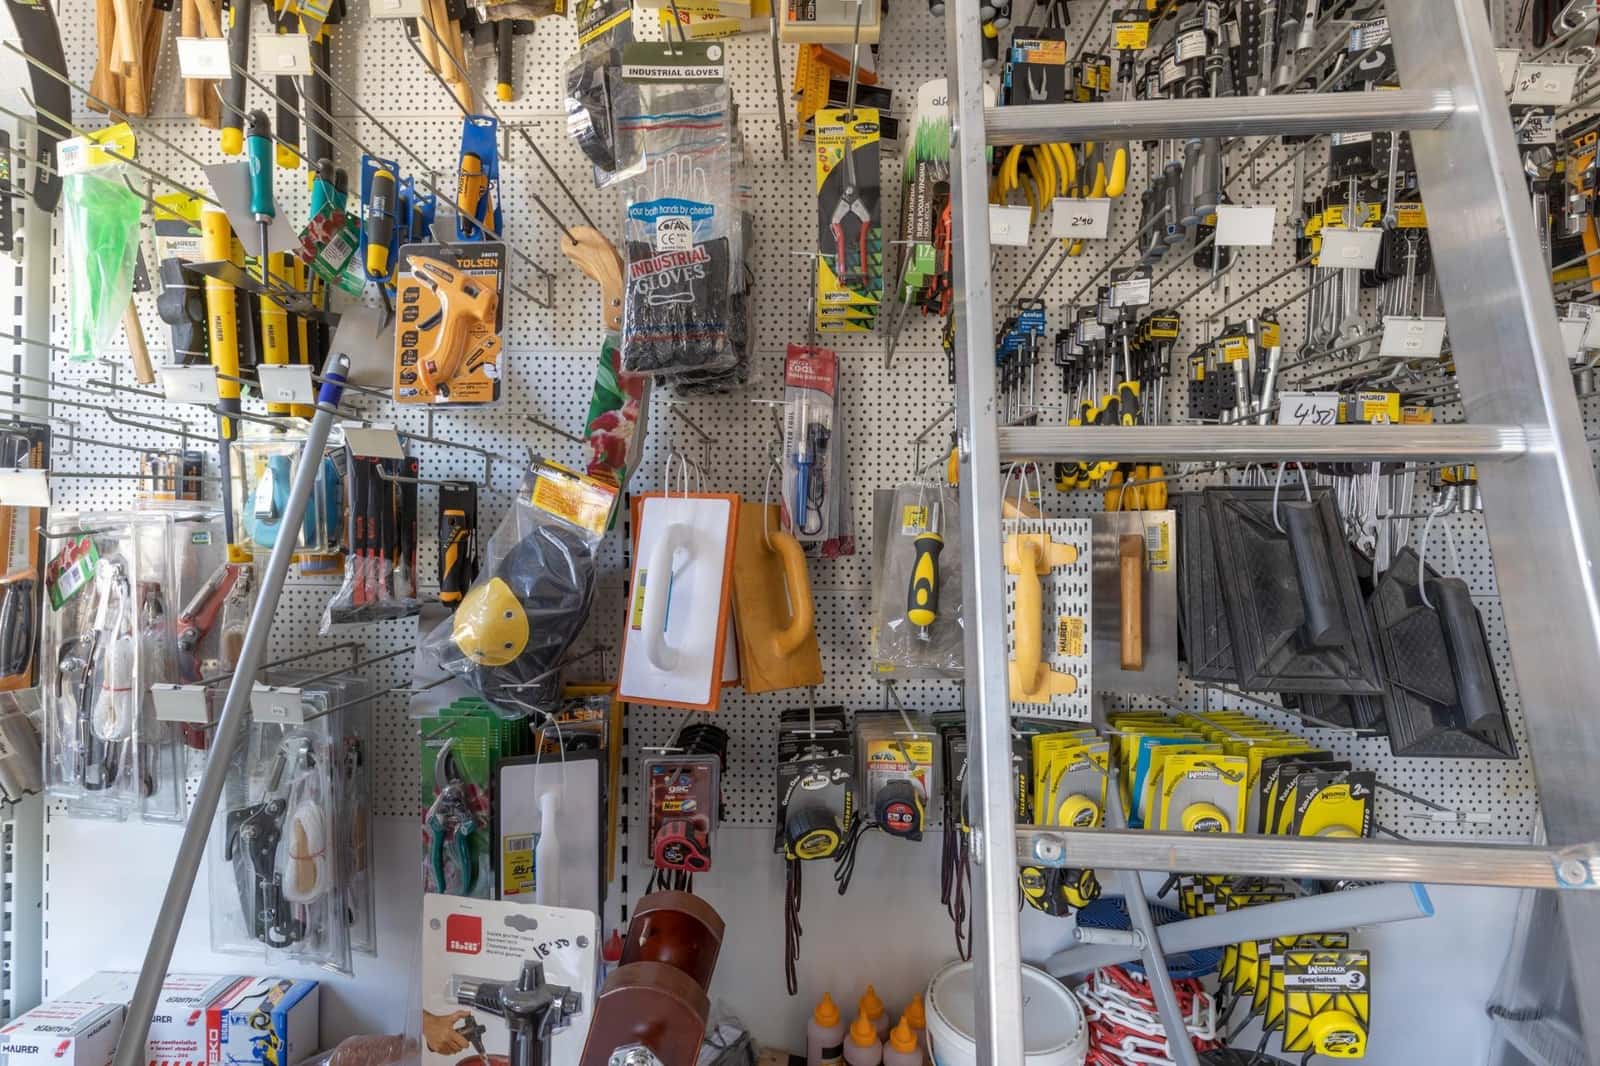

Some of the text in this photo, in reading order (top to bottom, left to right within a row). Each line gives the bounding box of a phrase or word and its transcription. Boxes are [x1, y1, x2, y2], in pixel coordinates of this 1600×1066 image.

[628, 68, 720, 77] INDUSTRIAL GLOVES
[918, 162, 926, 194] VENDIMIA
[659, 206, 679, 215] hands
[680, 206, 689, 215] by
[917, 194, 925, 217] PODAR
[456, 259, 499, 269] TOLSEN
[630, 246, 711, 280] INDUSTRIAL
[636, 264, 707, 295] GLOVES
[557, 709, 604, 722] OLSEN
[1307, 965, 1347, 974] WOLFPACK
[1297, 976, 1337, 985] Specialist
[1350, 973, 1361, 984] 3
[150, 1015, 173, 1024] URER
[2, 1045, 39, 1054] MAURER
